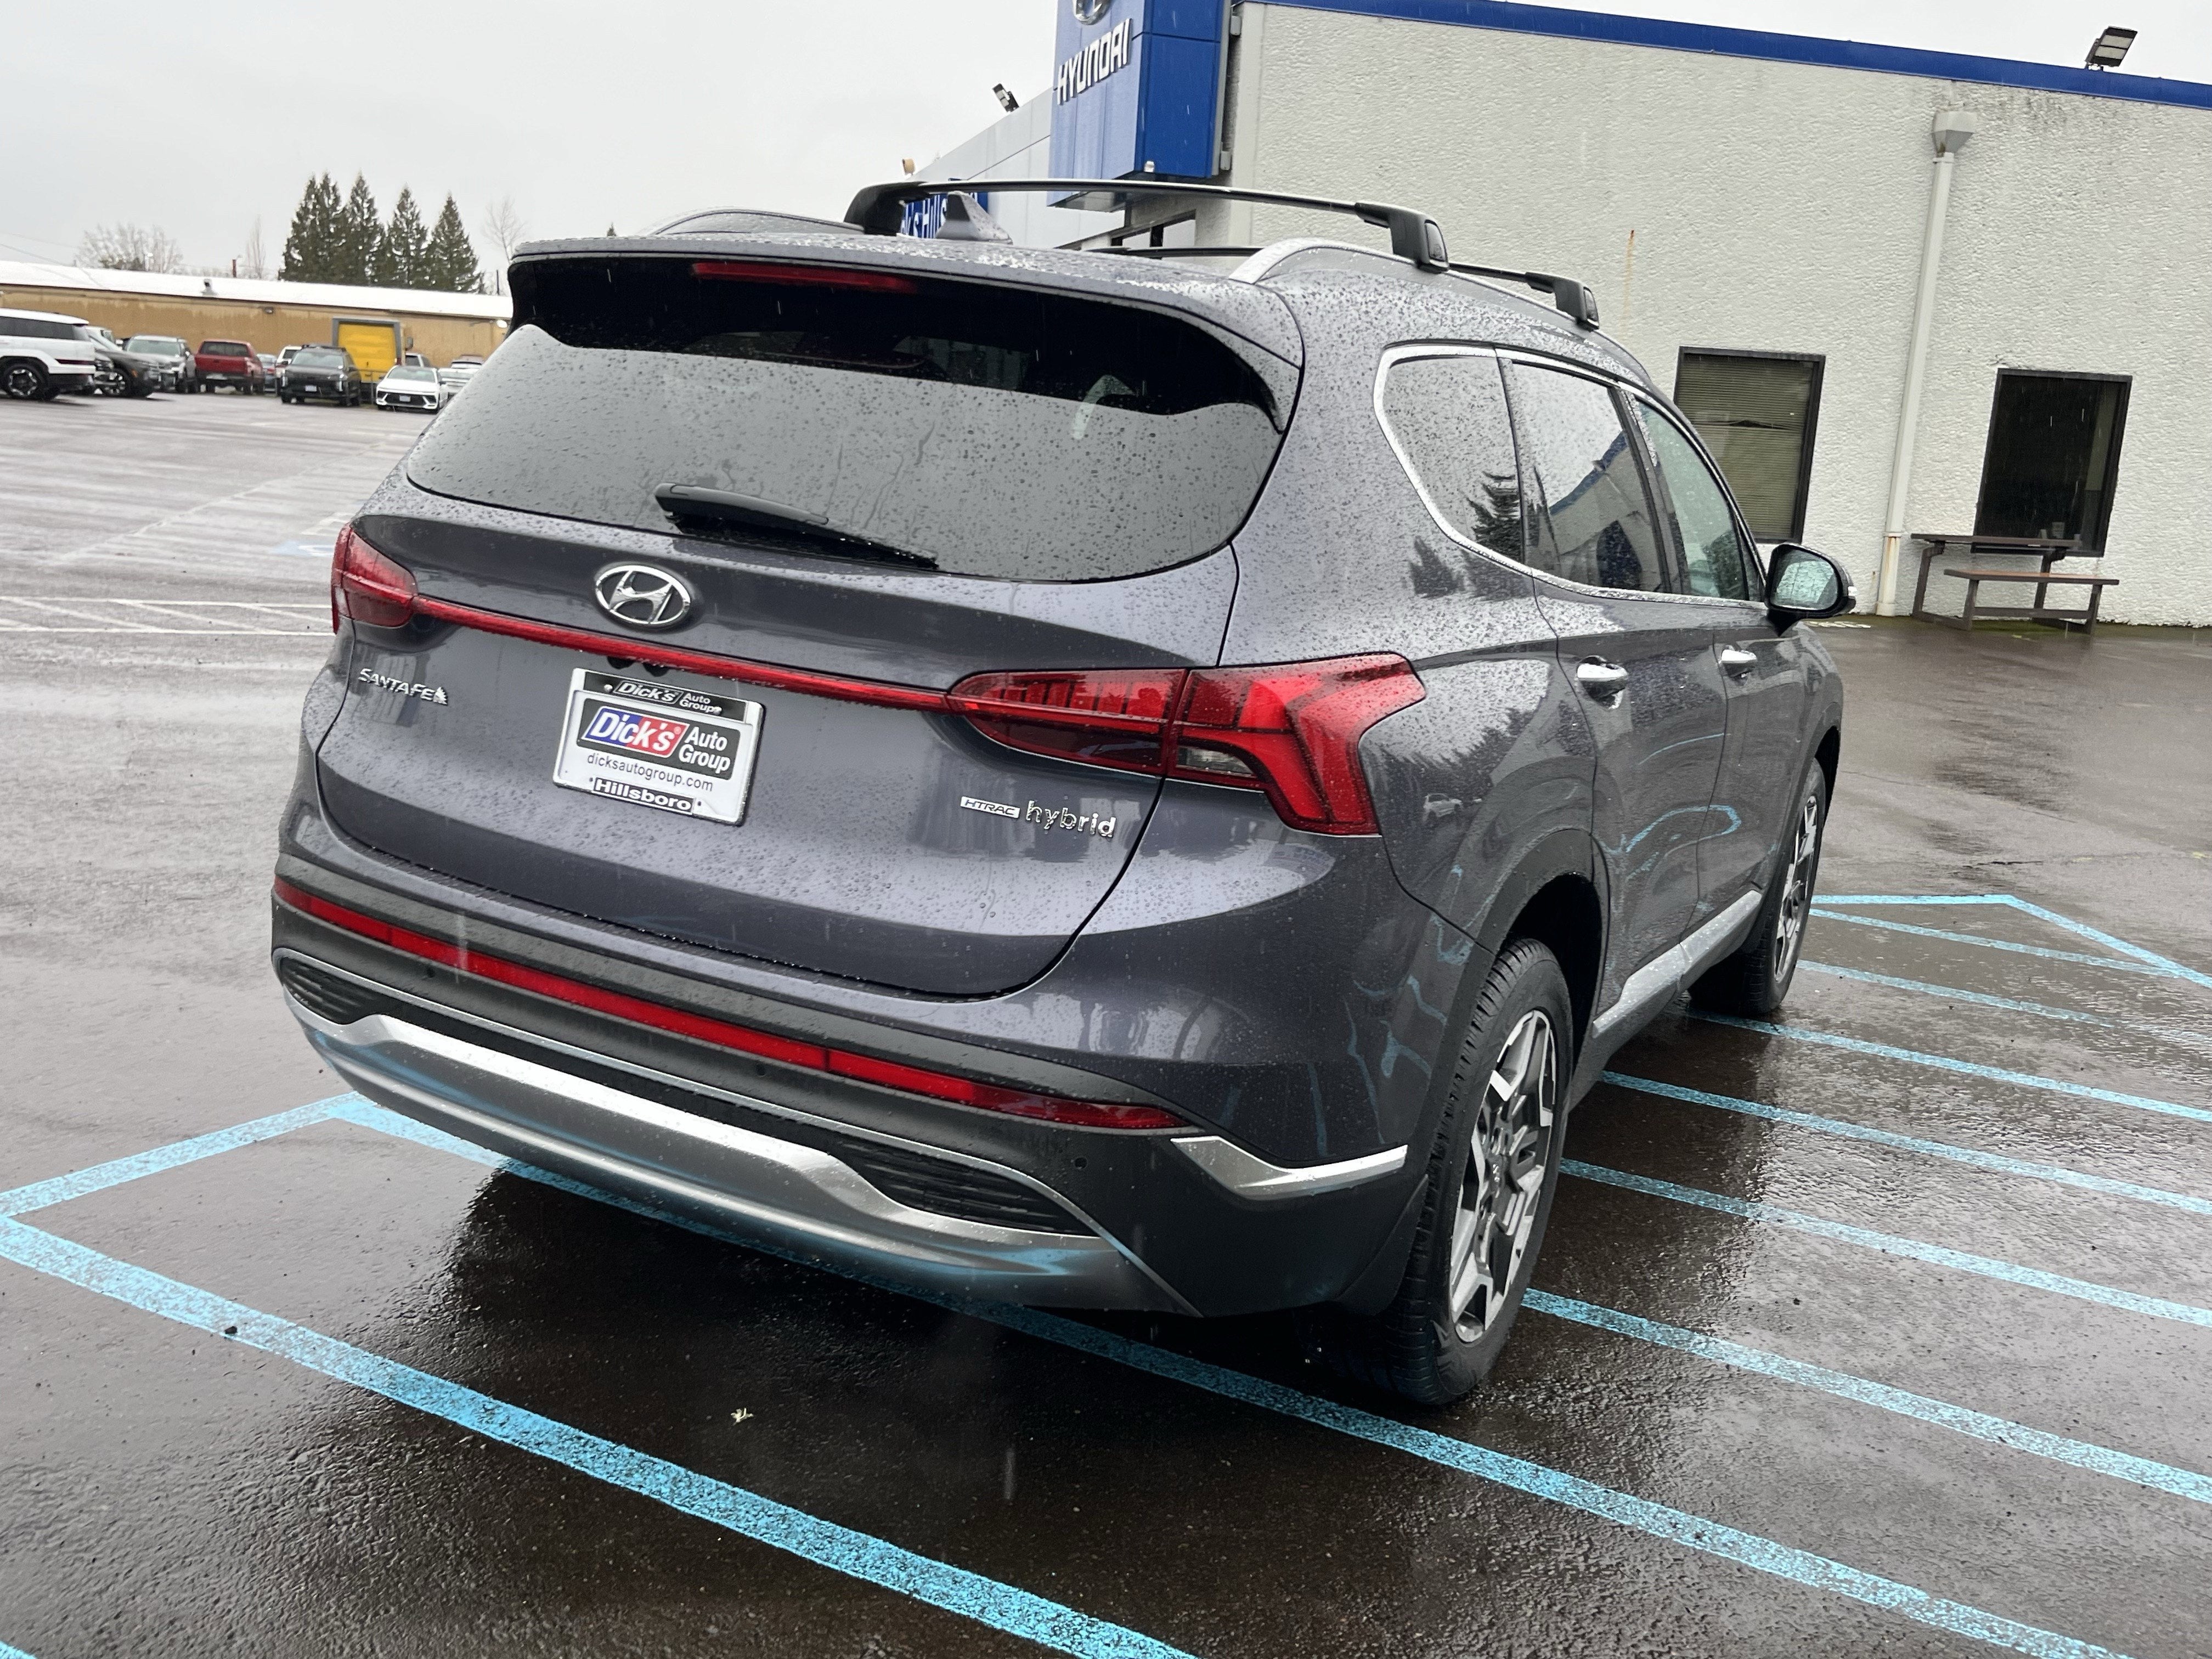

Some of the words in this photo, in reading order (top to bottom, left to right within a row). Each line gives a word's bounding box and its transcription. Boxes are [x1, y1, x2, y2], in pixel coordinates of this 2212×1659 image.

[1057, 18, 1131, 105] HYUNDAI
[618, 682, 676, 702] Dick's
[683, 692, 711, 704] Auto
[679, 699, 716, 714] Group
[590, 712, 675, 752] Dick's
[684, 726, 728, 752] Auto
[587, 752, 713, 792] dicksautogroup.com
[678, 744, 731, 774] Group
[595, 778, 691, 810] Hillsboro
[964, 799, 1017, 816] HTRAC
[1025, 800, 1116, 838] hybrid
